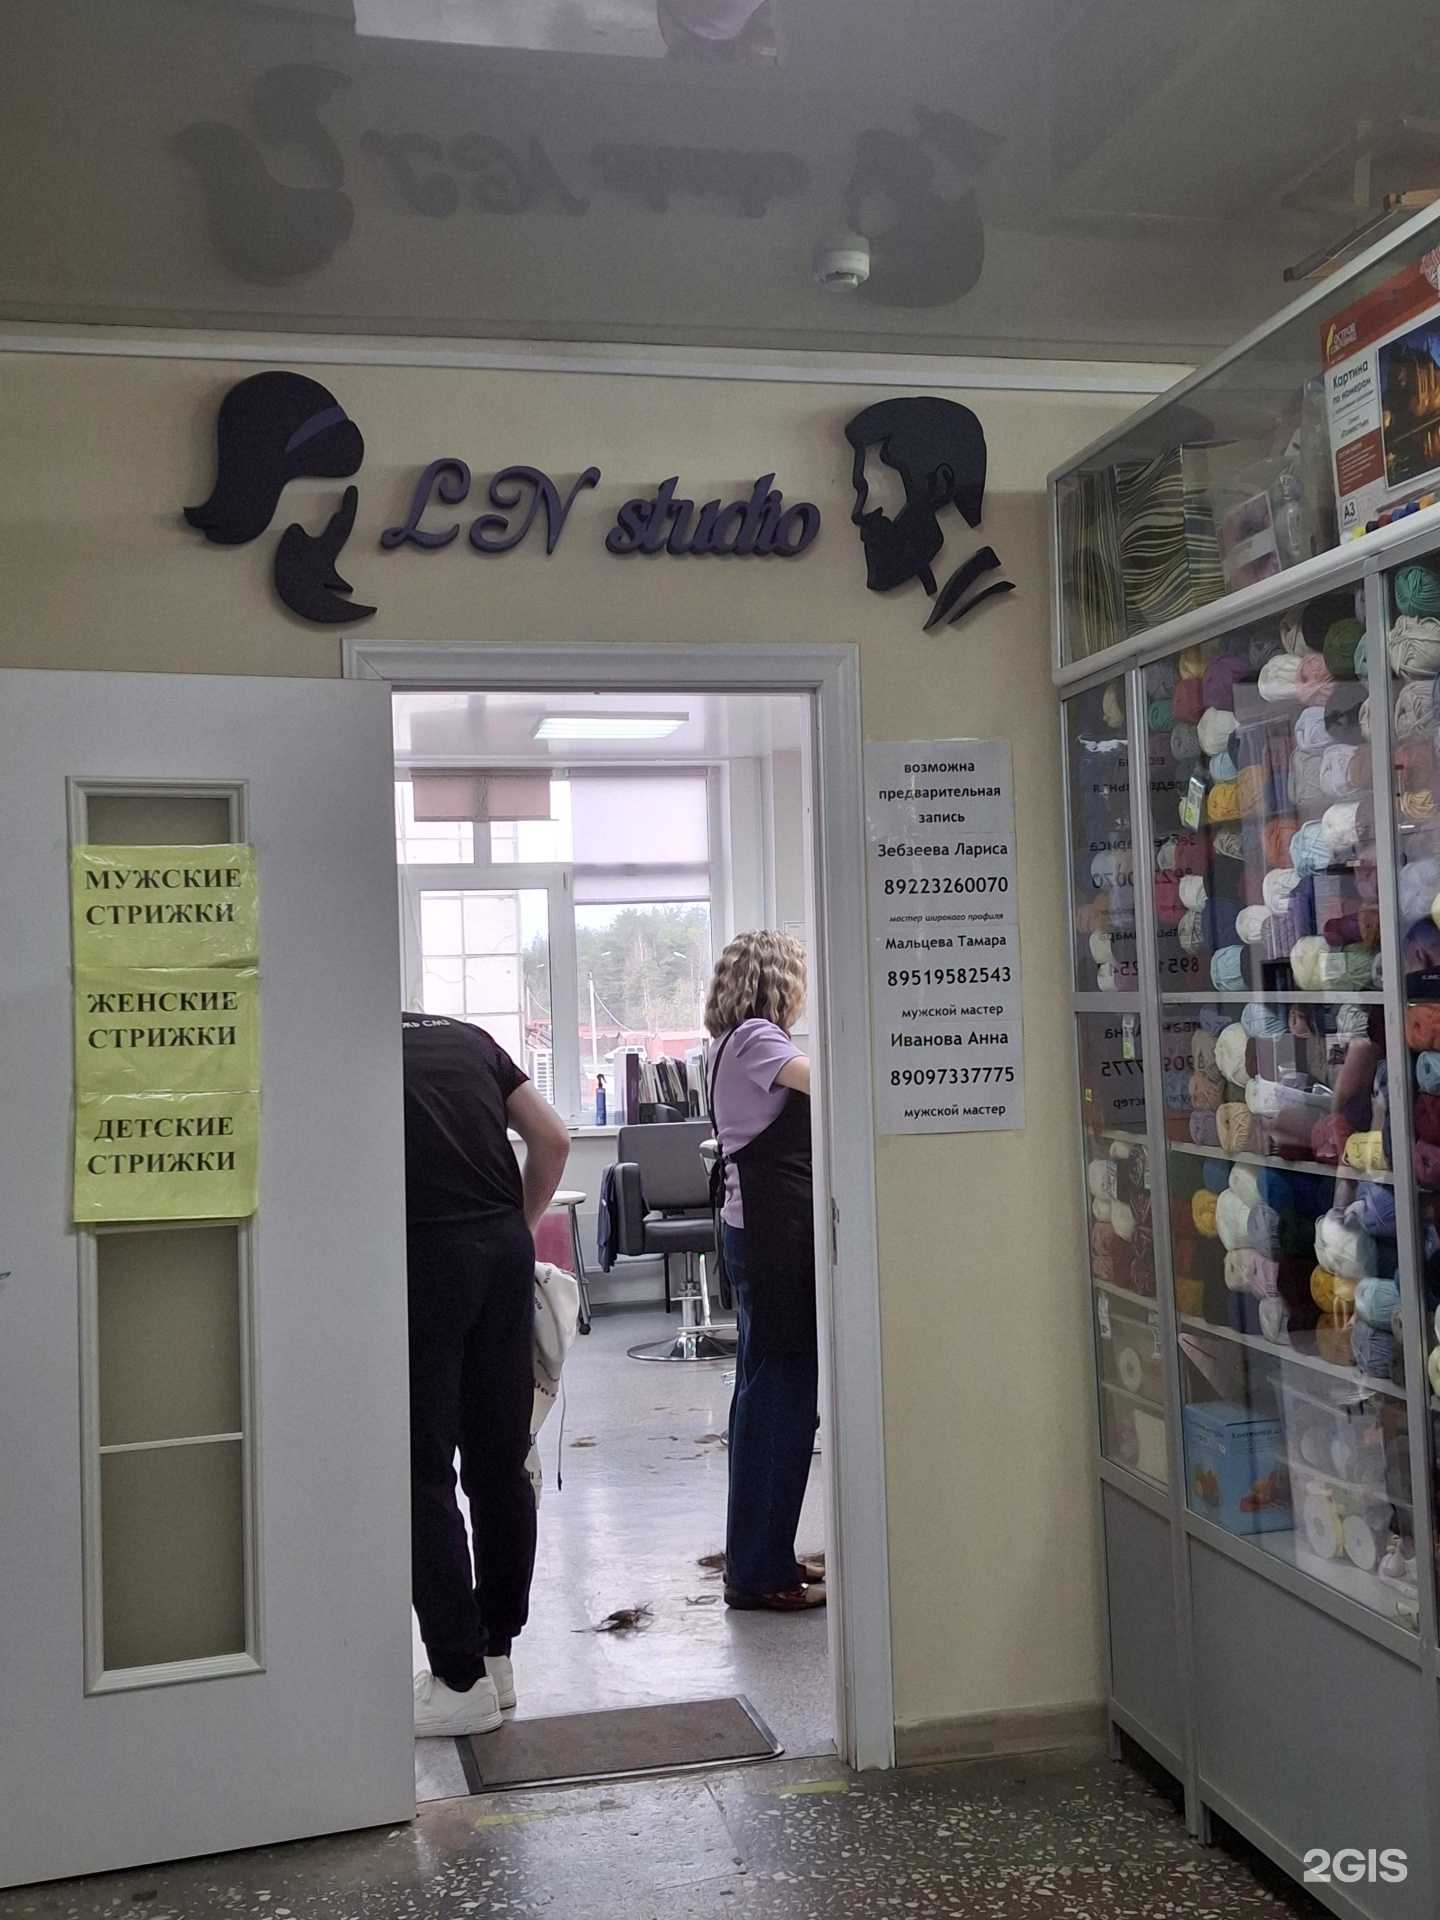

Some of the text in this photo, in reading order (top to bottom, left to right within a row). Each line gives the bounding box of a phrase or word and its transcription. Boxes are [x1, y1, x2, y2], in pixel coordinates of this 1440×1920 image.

[1333, 360, 1368, 389] Картина
[605, 472, 821, 554] studio
[904, 762, 975, 774] возможна
[879, 786, 1001, 801] предварительная
[919, 812, 965, 824] запись
[878, 842, 1008, 858] Зебзеева Лариса
[86, 867, 242, 890] МУЖСКИЕ
[884, 876, 1008, 895] 89223260070
[86, 902, 235, 926] СТРИЖКИ
[889, 911, 1004, 924] мастер широкого профиля
[885, 934, 1006, 950] Мальцева Тамара
[887, 966, 1011, 987] 89519582543
[87, 991, 238, 1015] ЖЕНСКИЕ
[902, 1004, 1003, 1020] мужской мастер
[87, 1026, 237, 1049] СТРИЖКИ
[891, 1031, 1009, 1048] Иванова Анна
[890, 1066, 1014, 1086] 89097337775
[904, 1104, 1006, 1120] мужской мастер
[93, 1116, 234, 1143] ДЕТСКИЕ
[87, 1150, 236, 1175] СТРИЖКИ
